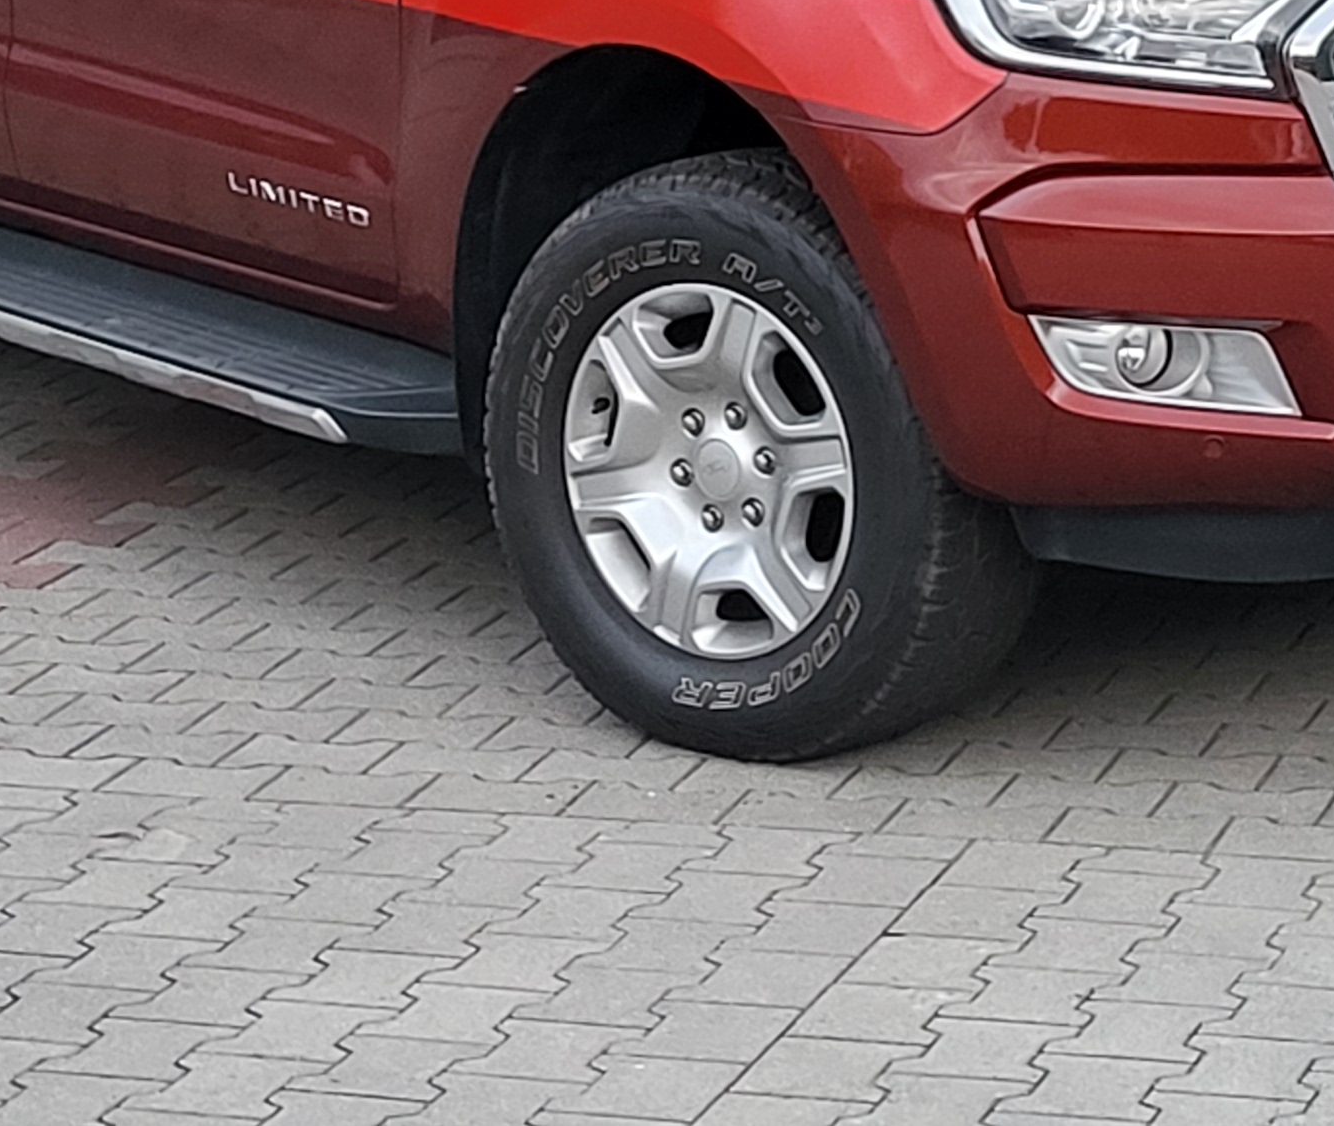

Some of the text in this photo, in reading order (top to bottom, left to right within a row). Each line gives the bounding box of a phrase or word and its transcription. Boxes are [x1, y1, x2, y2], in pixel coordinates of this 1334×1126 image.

[228, 172, 369, 227] LIMITED
[517, 238, 702, 475] DISCOVERER
[671, 588, 861, 710] COOPER
